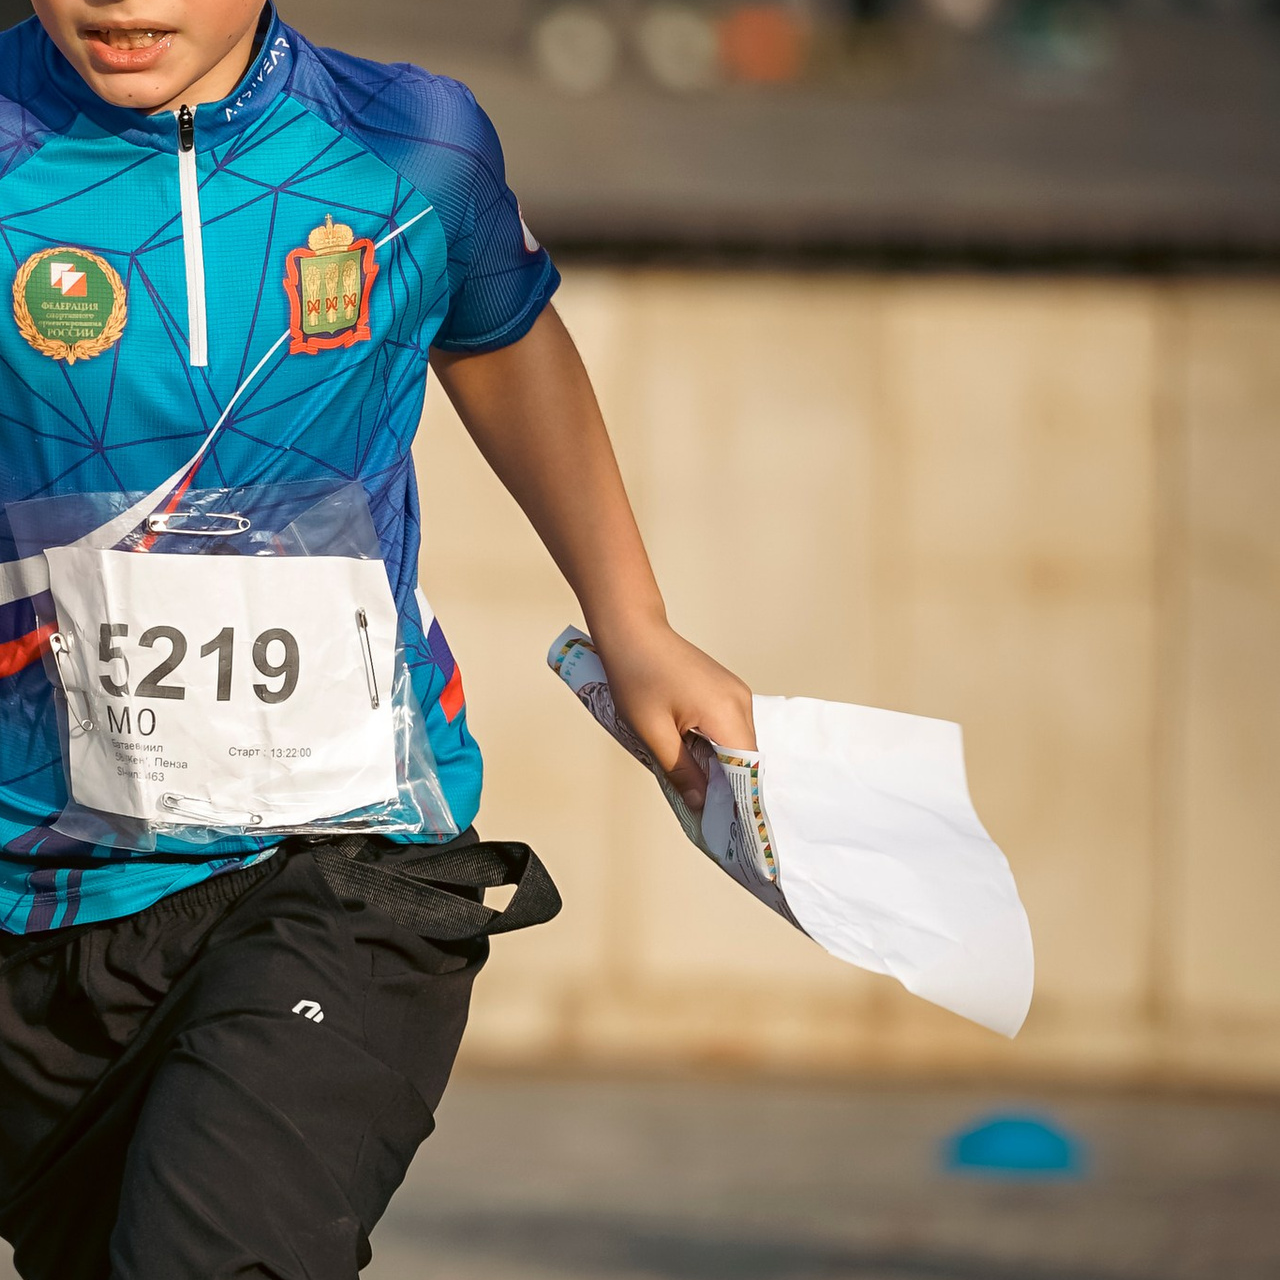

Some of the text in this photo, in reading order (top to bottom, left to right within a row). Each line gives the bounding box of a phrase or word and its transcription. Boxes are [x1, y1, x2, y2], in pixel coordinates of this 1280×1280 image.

[47, 328, 95, 337] РОССИИ
[98, 622, 301, 705] 5219
[228, 746, 261, 758] Старт
[270, 747, 312, 758] 13:22:00
[154, 757, 188, 769] Пенза
